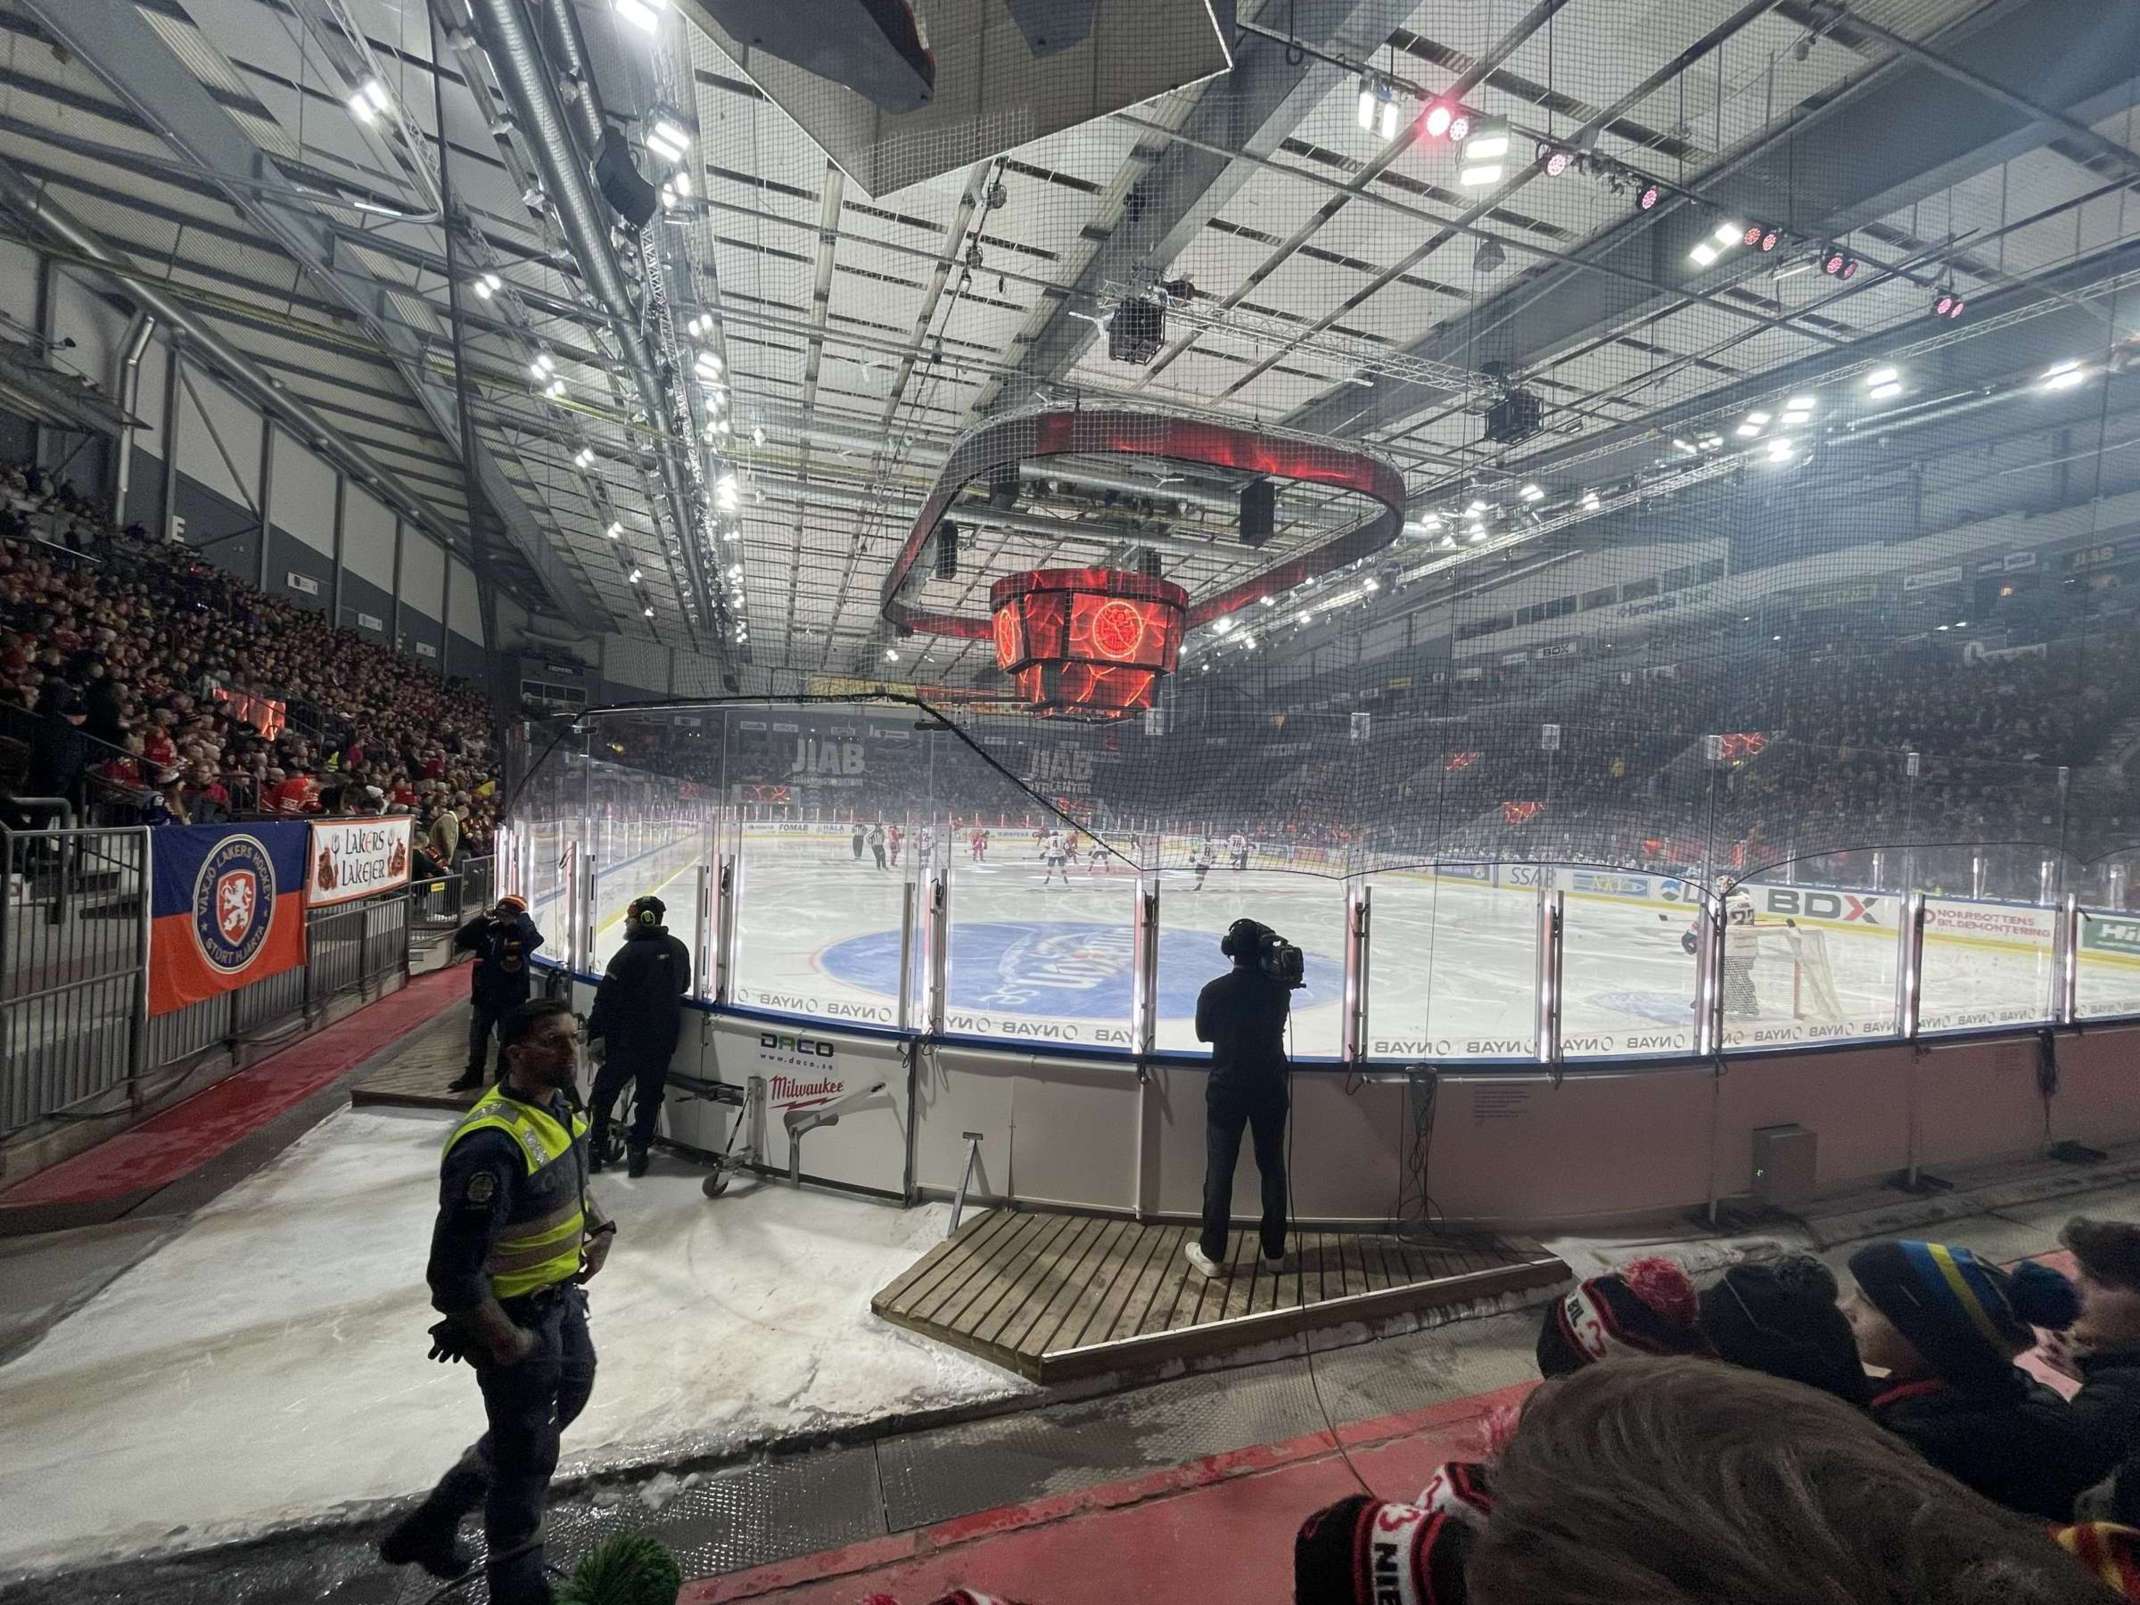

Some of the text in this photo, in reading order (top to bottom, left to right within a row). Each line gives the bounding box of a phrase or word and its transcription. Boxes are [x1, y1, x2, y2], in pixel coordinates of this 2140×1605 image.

[172, 515, 186, 542] E
[1767, 887, 1879, 925] BDX
[1937, 908, 2035, 927] NORRBOTTENS
[1937, 919, 2050, 938] BILDEMONTERING
[2098, 922, 2140, 942] Hi
[760, 1032, 834, 1058] DACO
[769, 1074, 844, 1101] Milwaukee
